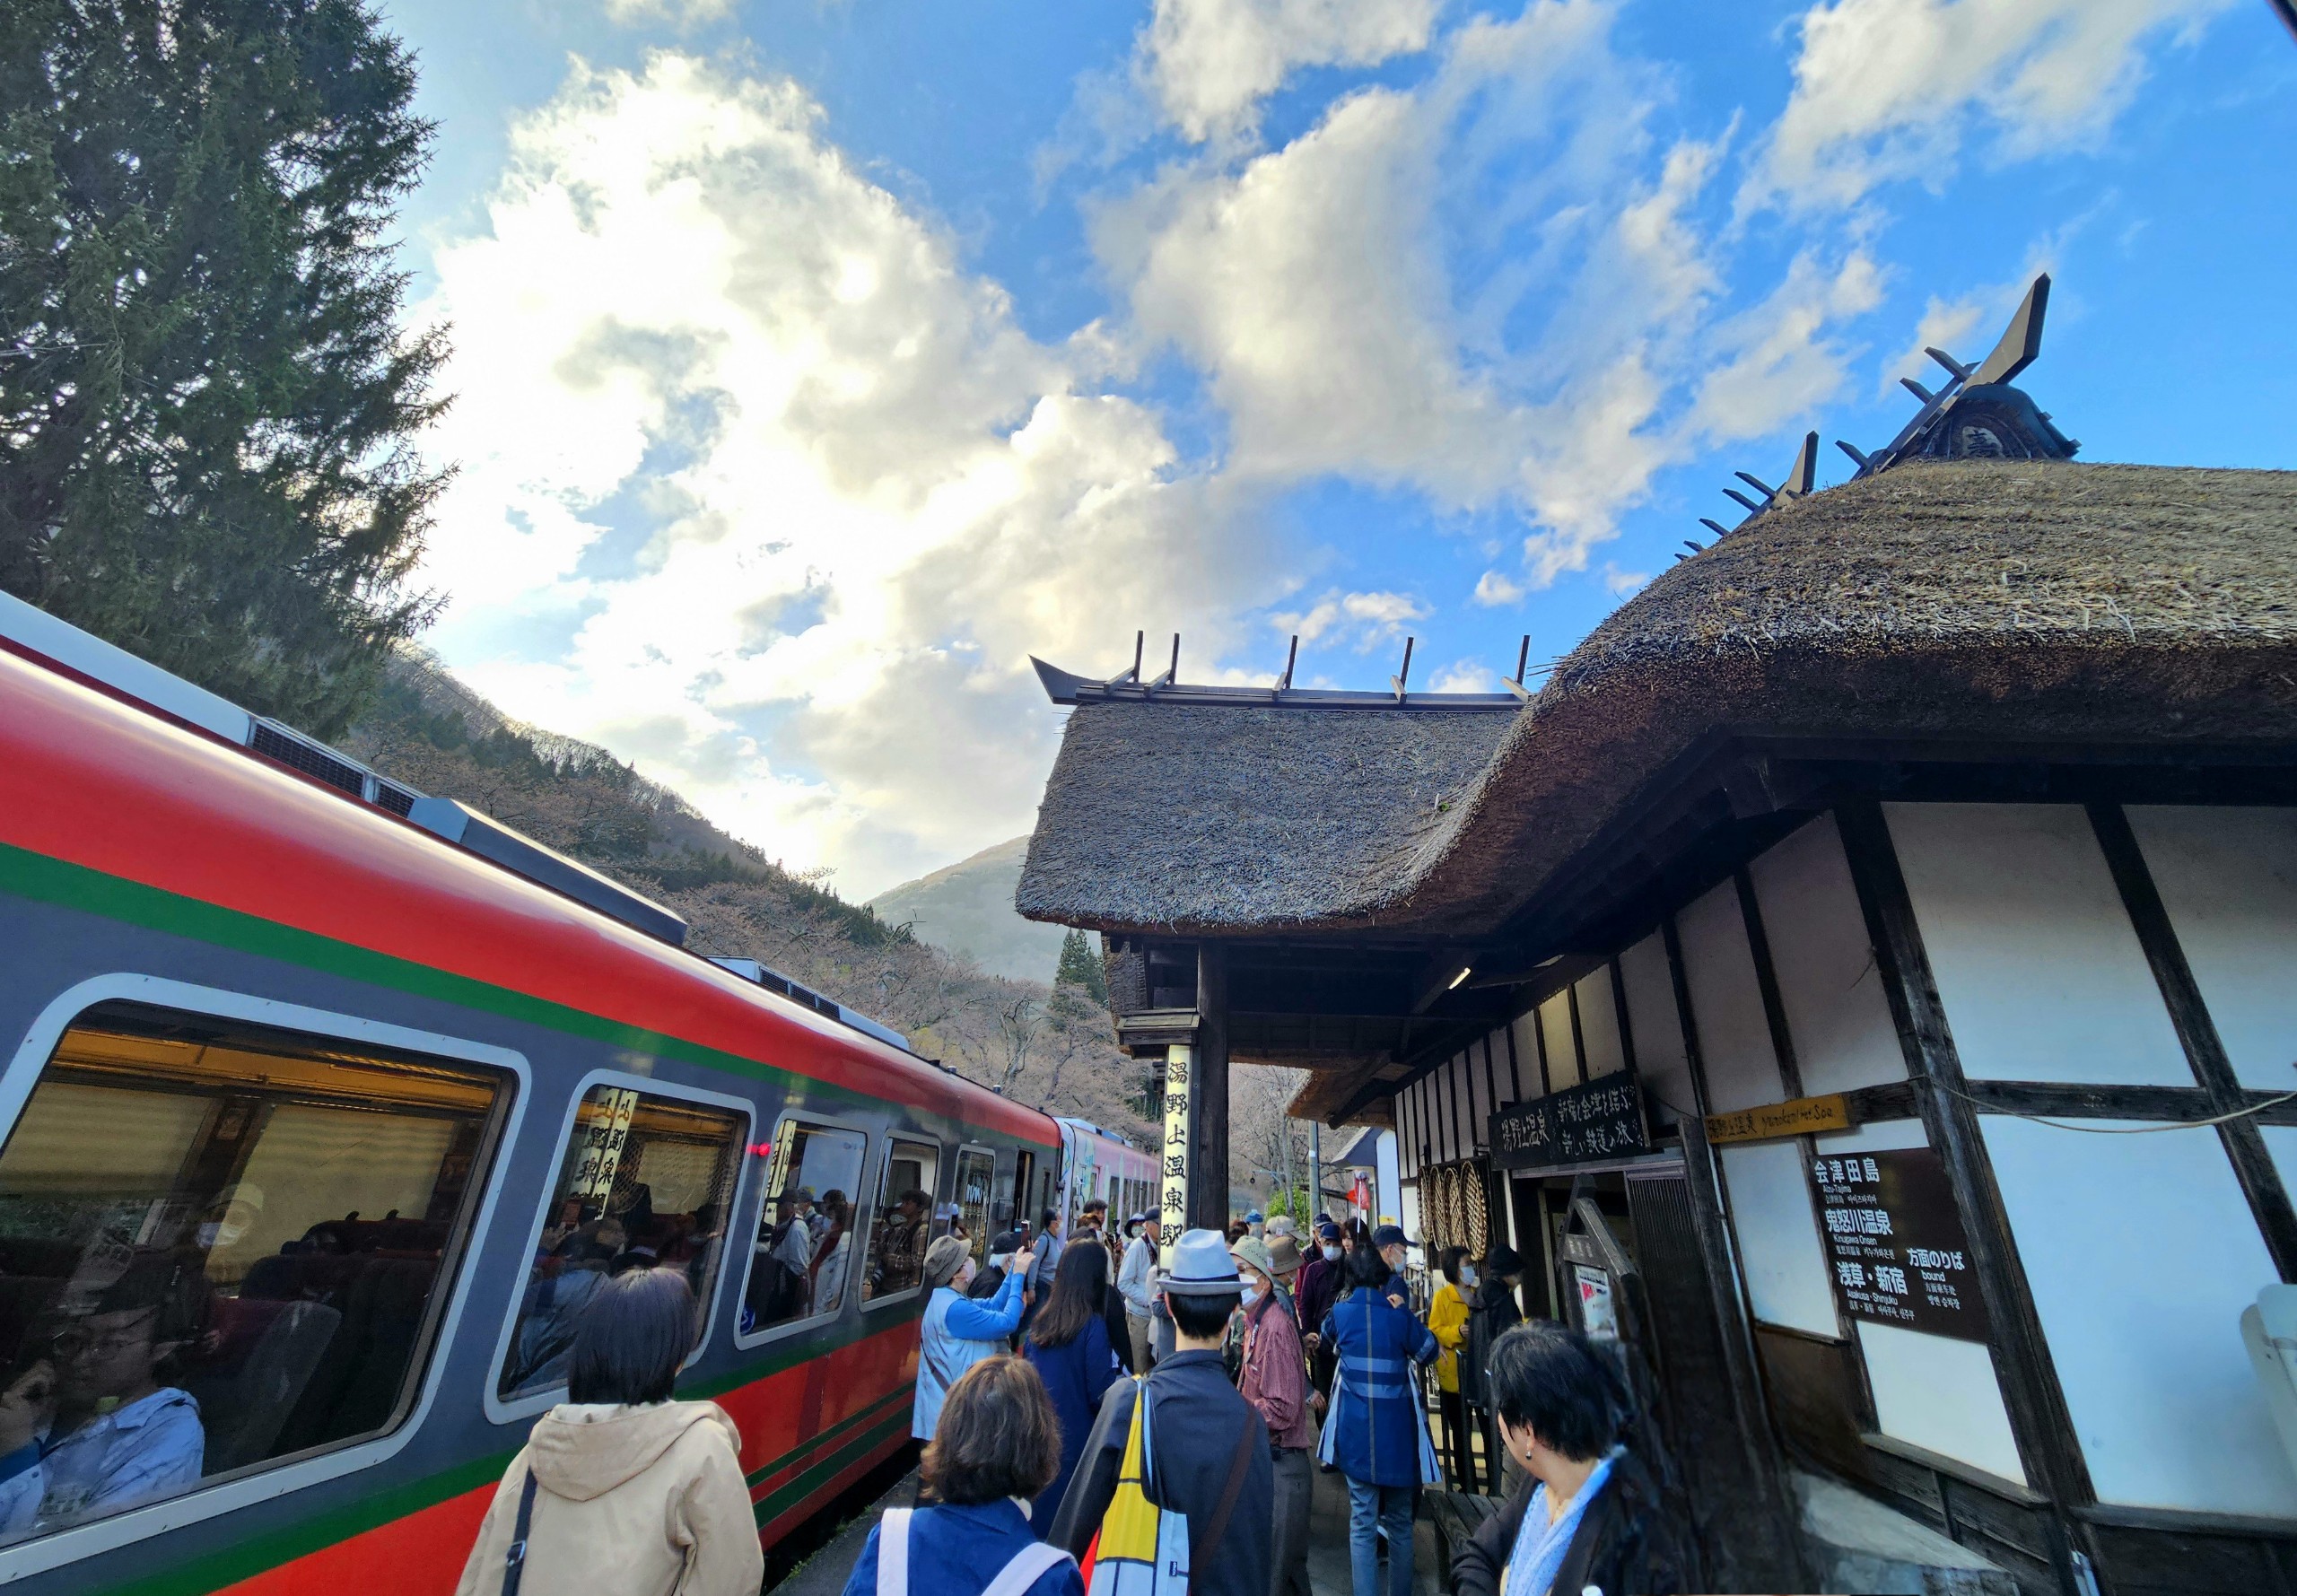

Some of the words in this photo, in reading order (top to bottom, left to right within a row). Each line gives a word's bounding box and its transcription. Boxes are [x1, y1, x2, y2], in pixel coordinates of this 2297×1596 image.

[1501, 1108, 1550, 1153] 湯野上温泉
[1160, 1061, 1189, 1247] 湯野上温泉駅
[1814, 1157, 1881, 1183] 会津田島
[1822, 1184, 1852, 1195] Aizu-Tajima
[1825, 1208, 1893, 1235] 鬼怒川温泉
[1833, 1234, 1859, 1244] Kinugawa
[1860, 1236, 1878, 1246] Onsen
[1906, 1247, 1965, 1271] 方面のりば
[1837, 1260, 1908, 1295] 浅草・新宿
[1920, 1269, 1946, 1282] bound
